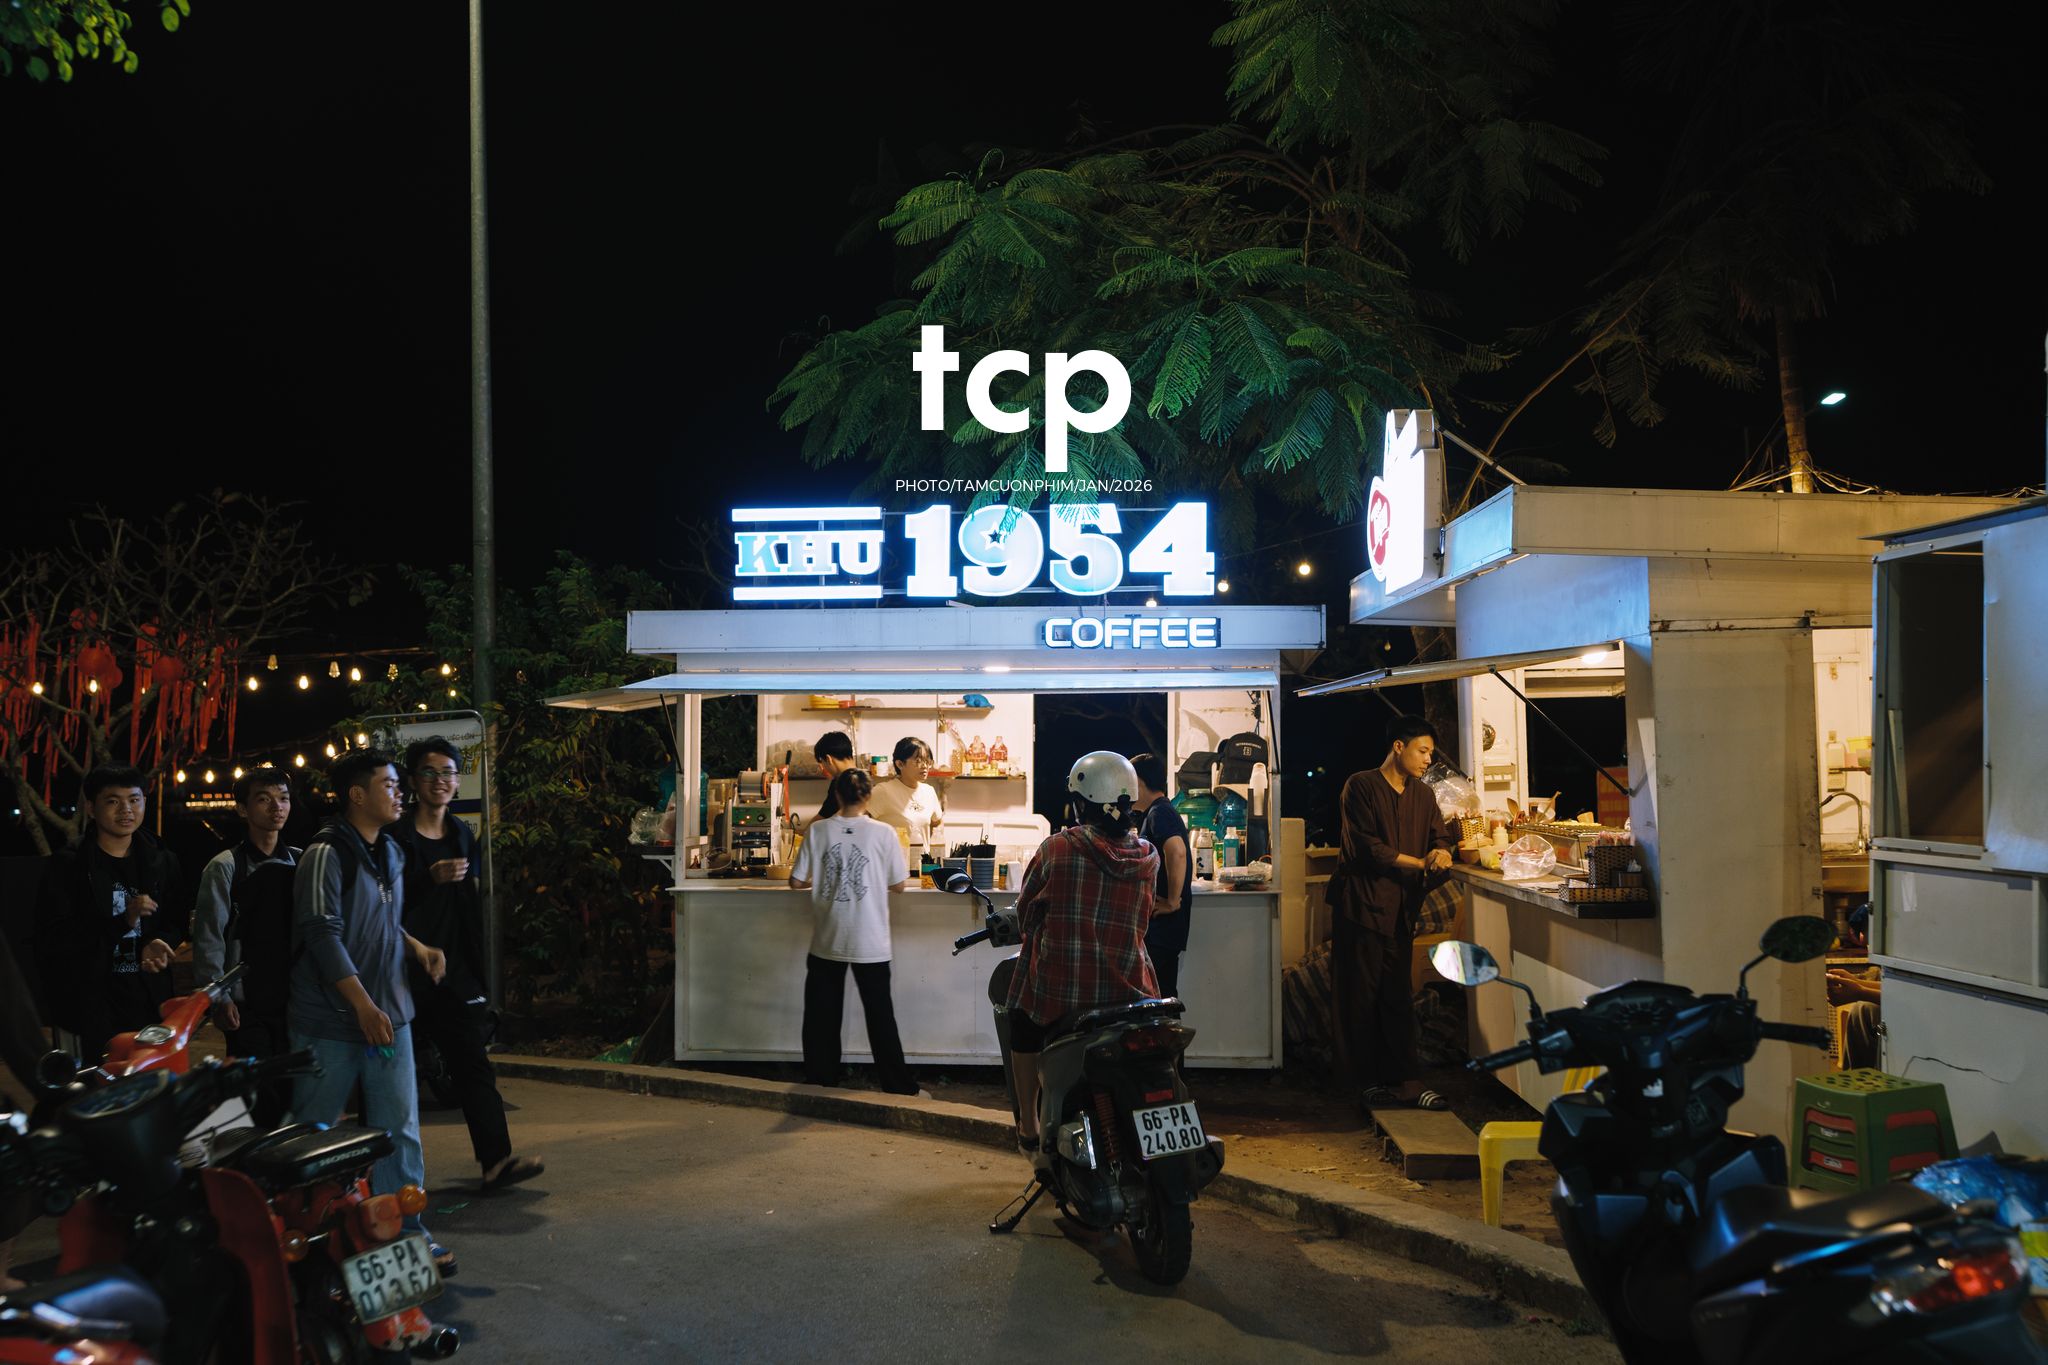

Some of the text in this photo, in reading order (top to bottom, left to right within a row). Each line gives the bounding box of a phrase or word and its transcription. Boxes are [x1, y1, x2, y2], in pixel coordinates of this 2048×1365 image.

[735, 501, 1216, 597] KHU 1954
[1044, 616, 1218, 649] COFFEE
[1141, 1105, 1191, 1131] 66-PA
[1143, 1126, 1202, 1155] 240.80
[320, 1147, 370, 1166] HONDA
[356, 1239, 421, 1285] 66-PA
